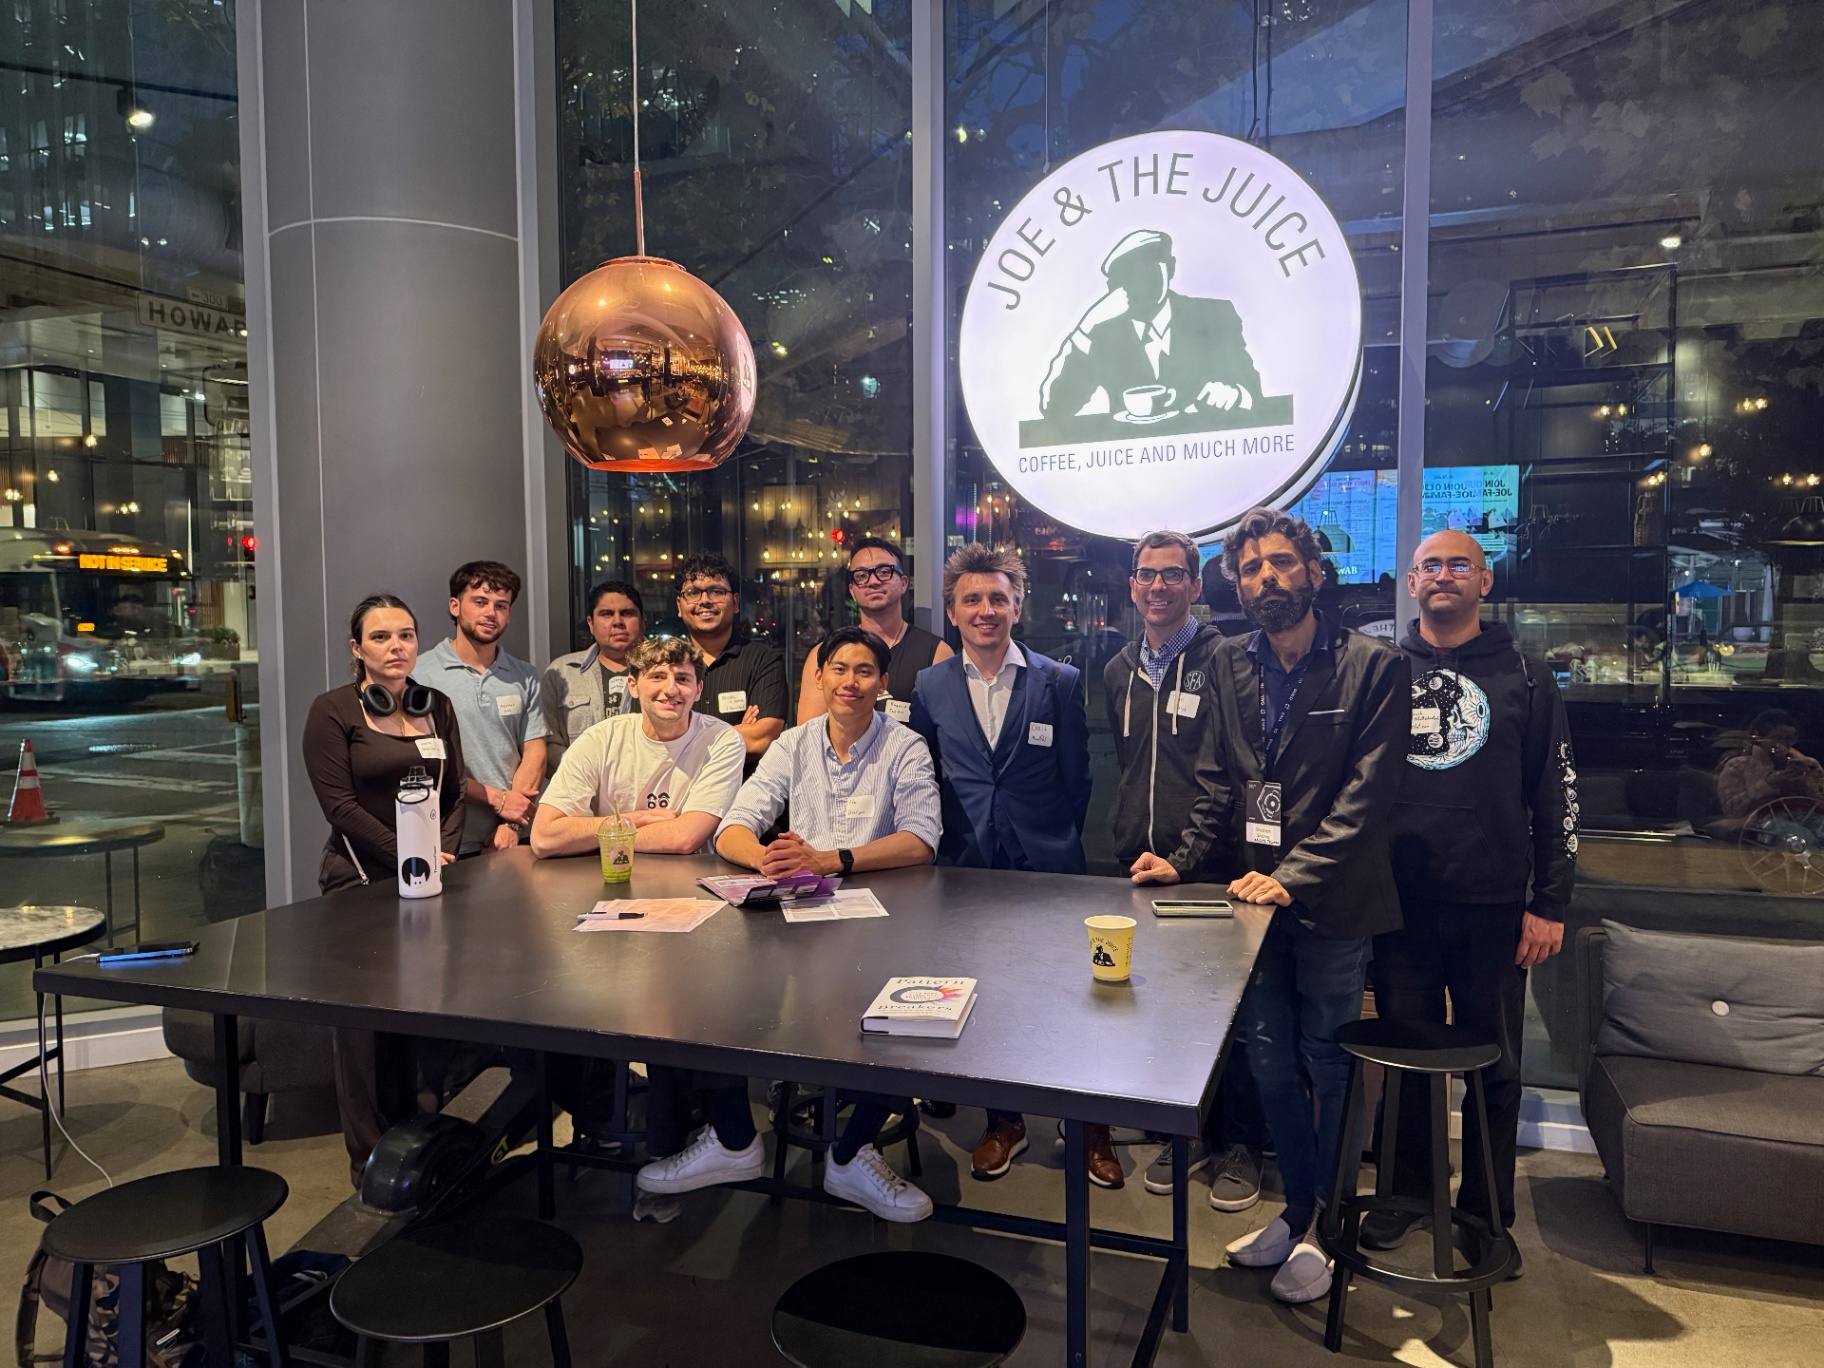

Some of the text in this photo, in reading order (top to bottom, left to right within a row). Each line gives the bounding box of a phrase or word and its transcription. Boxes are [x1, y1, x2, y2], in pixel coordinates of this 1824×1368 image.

[987, 152, 1326, 311] JOE & THE JUICE
[204, 292, 222, 306] 300
[1018, 434, 1295, 473] COFFEE, JUICE AND MUCH MORE
[79, 553, 168, 572] NOT IN SERVICE
[1184, 672, 1202, 690] SFA
